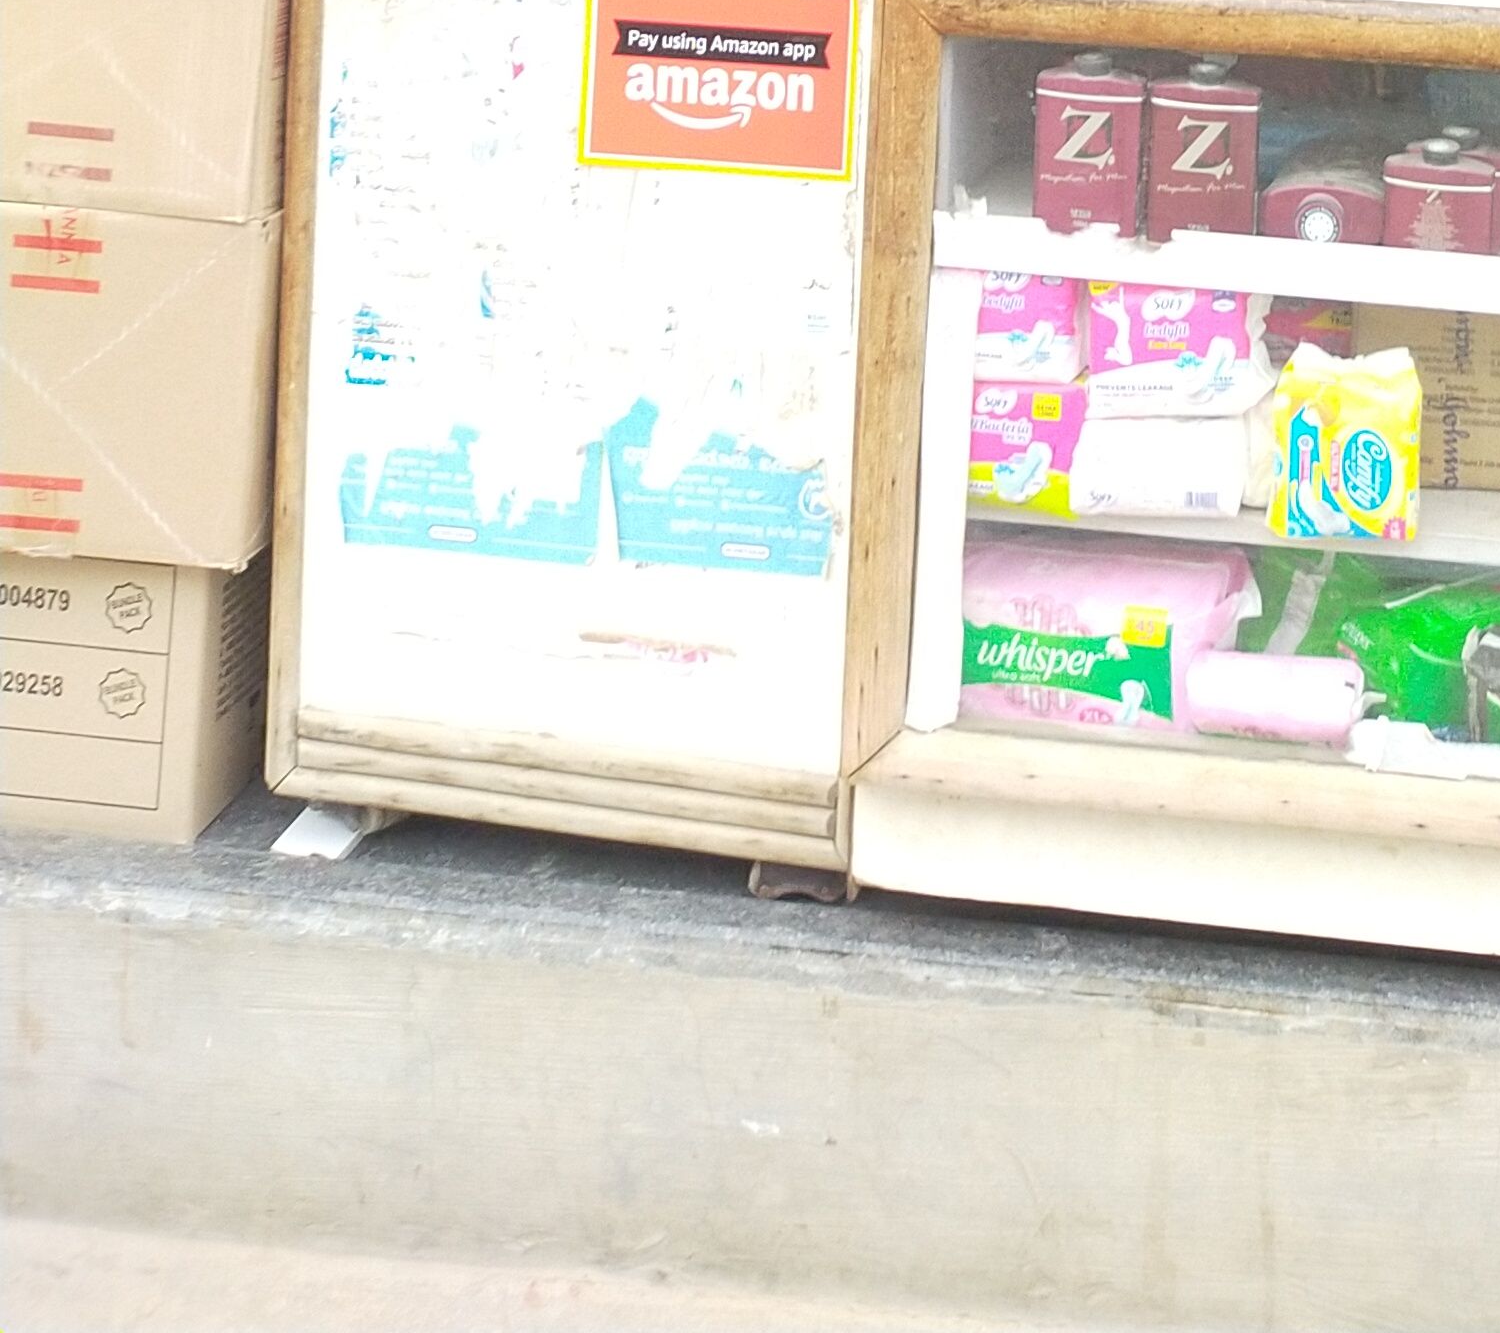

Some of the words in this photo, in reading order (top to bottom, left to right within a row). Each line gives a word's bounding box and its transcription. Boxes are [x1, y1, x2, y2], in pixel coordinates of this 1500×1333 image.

[627, 29, 659, 52] Pay
[661, 32, 707, 56] using
[710, 35, 780, 57] Amazon
[781, 41, 817, 62] app
[624, 62, 815, 113] amazon
[977, 631, 1101, 682] whisper
